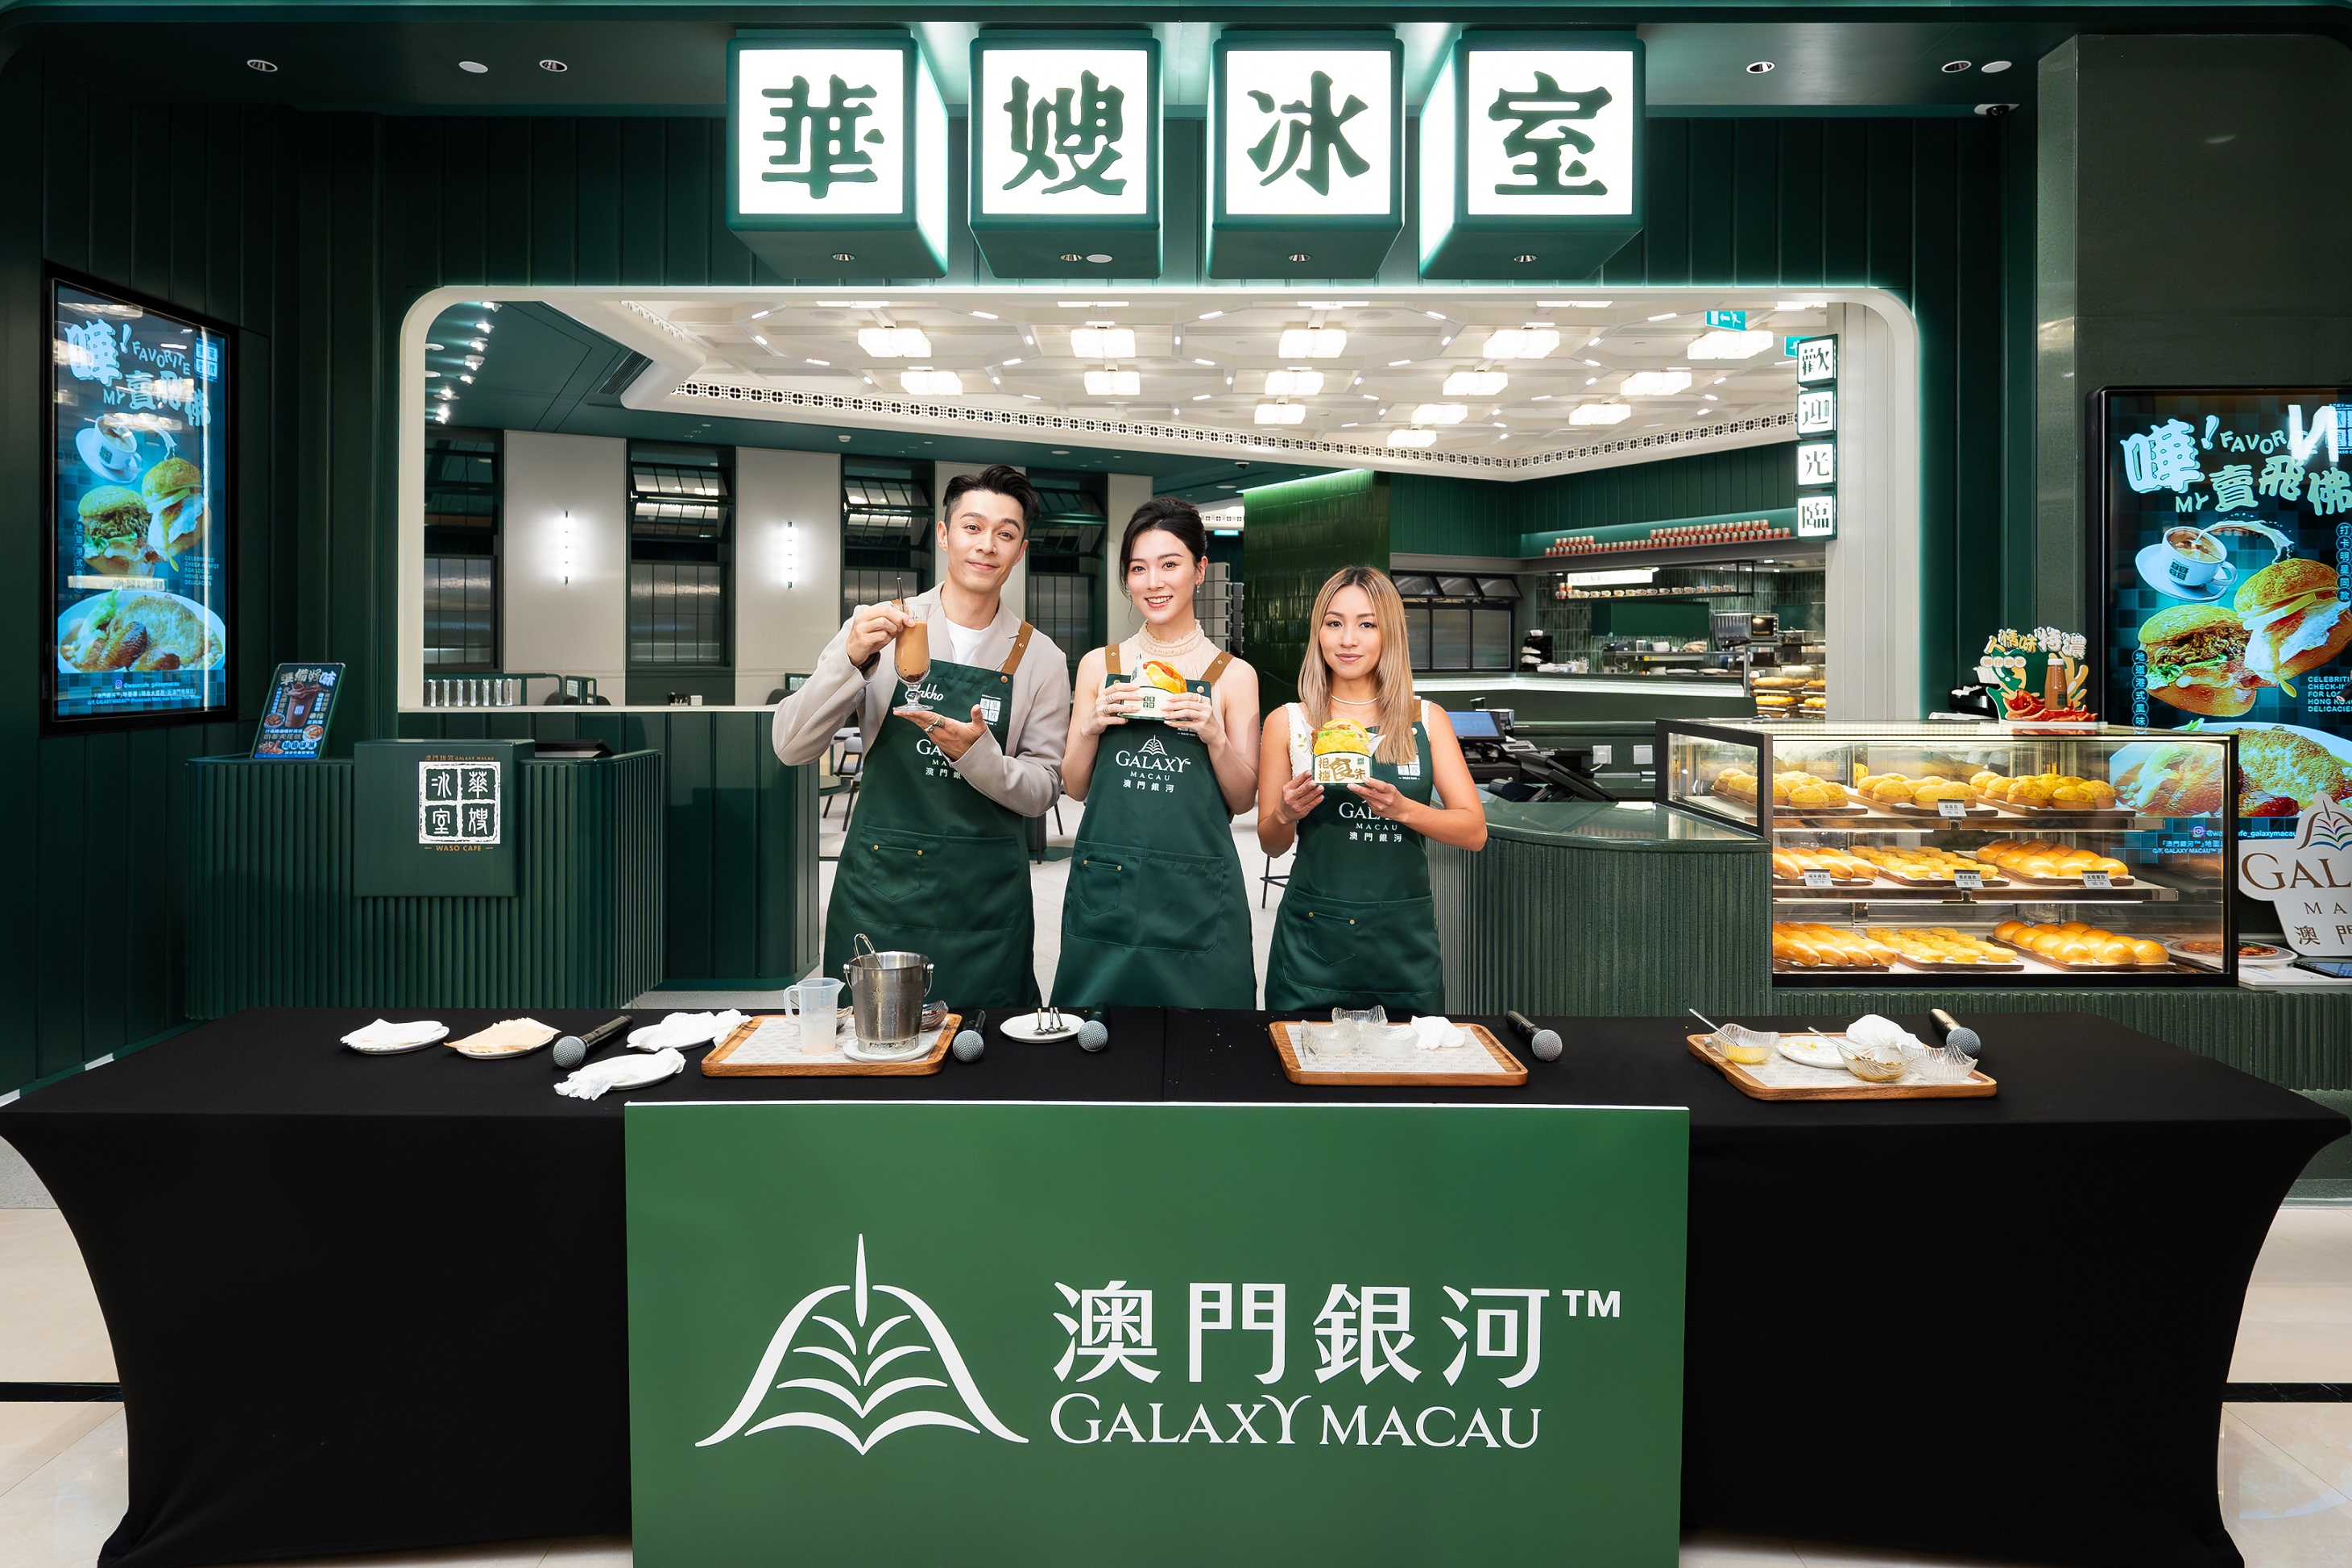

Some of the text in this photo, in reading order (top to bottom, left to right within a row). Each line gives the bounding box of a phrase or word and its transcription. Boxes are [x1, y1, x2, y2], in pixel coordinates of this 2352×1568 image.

[761, 69, 1613, 199] 華嫂冰室
[132, 341, 191, 375] FAVORITE
[1801, 347, 1830, 529] 歡迎光臨
[2209, 454, 2352, 516] 賣飛佛
[2176, 492, 2209, 512] MY
[1984, 627, 2086, 660] 人情味特濃
[917, 683, 944, 701] akho
[925, 767, 962, 780] 澳門銀
[1130, 771, 1171, 781] MACAU
[1123, 779, 1175, 793] 澳門銀河
[1339, 802, 1392, 821] GAL
[1356, 822, 1398, 831] MACAU
[1349, 831, 1402, 842] 澳門銀河
[1050, 1392, 1542, 1449] GALAXY MACAU
